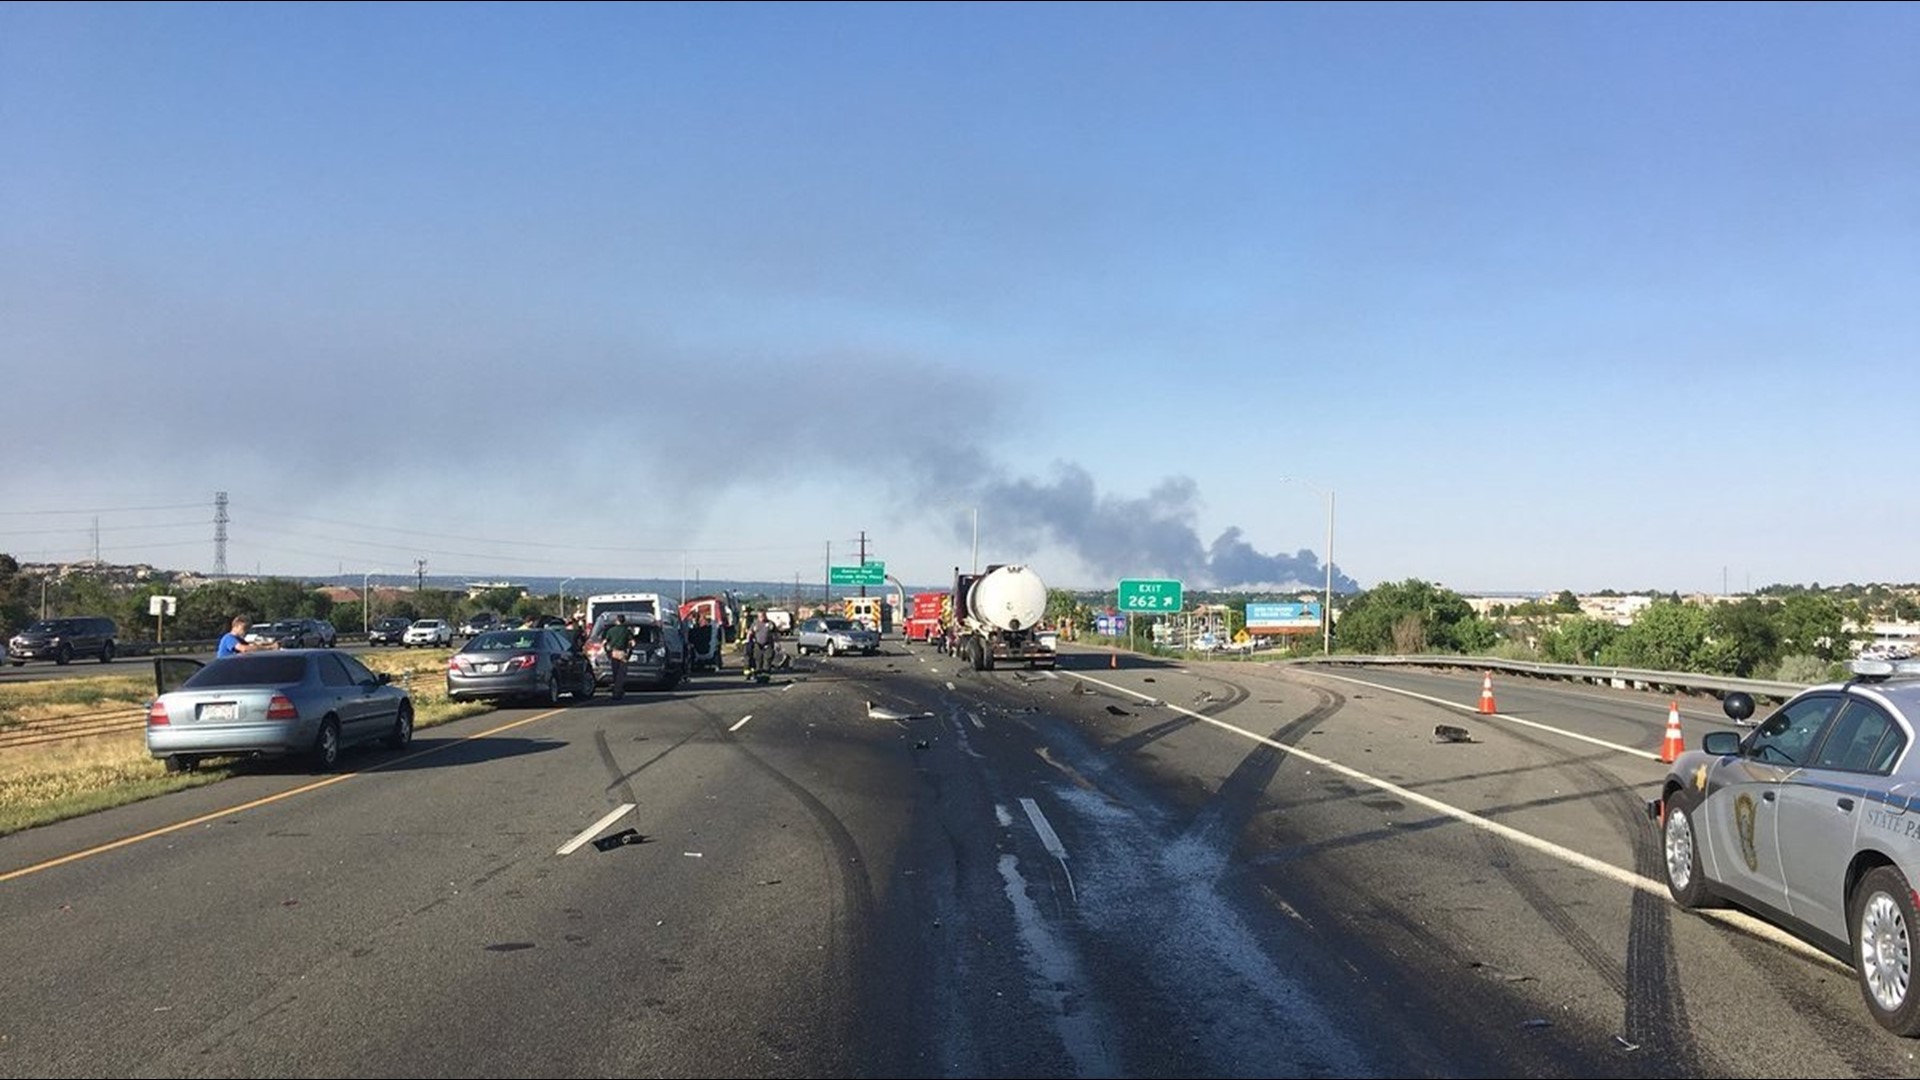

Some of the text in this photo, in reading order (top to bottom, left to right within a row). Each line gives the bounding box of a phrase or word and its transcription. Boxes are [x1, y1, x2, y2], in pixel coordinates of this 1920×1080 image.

[1139, 584, 1161, 592] EXIT
[1129, 596, 1157, 607] 262
[1867, 810, 1904, 833] STATE
